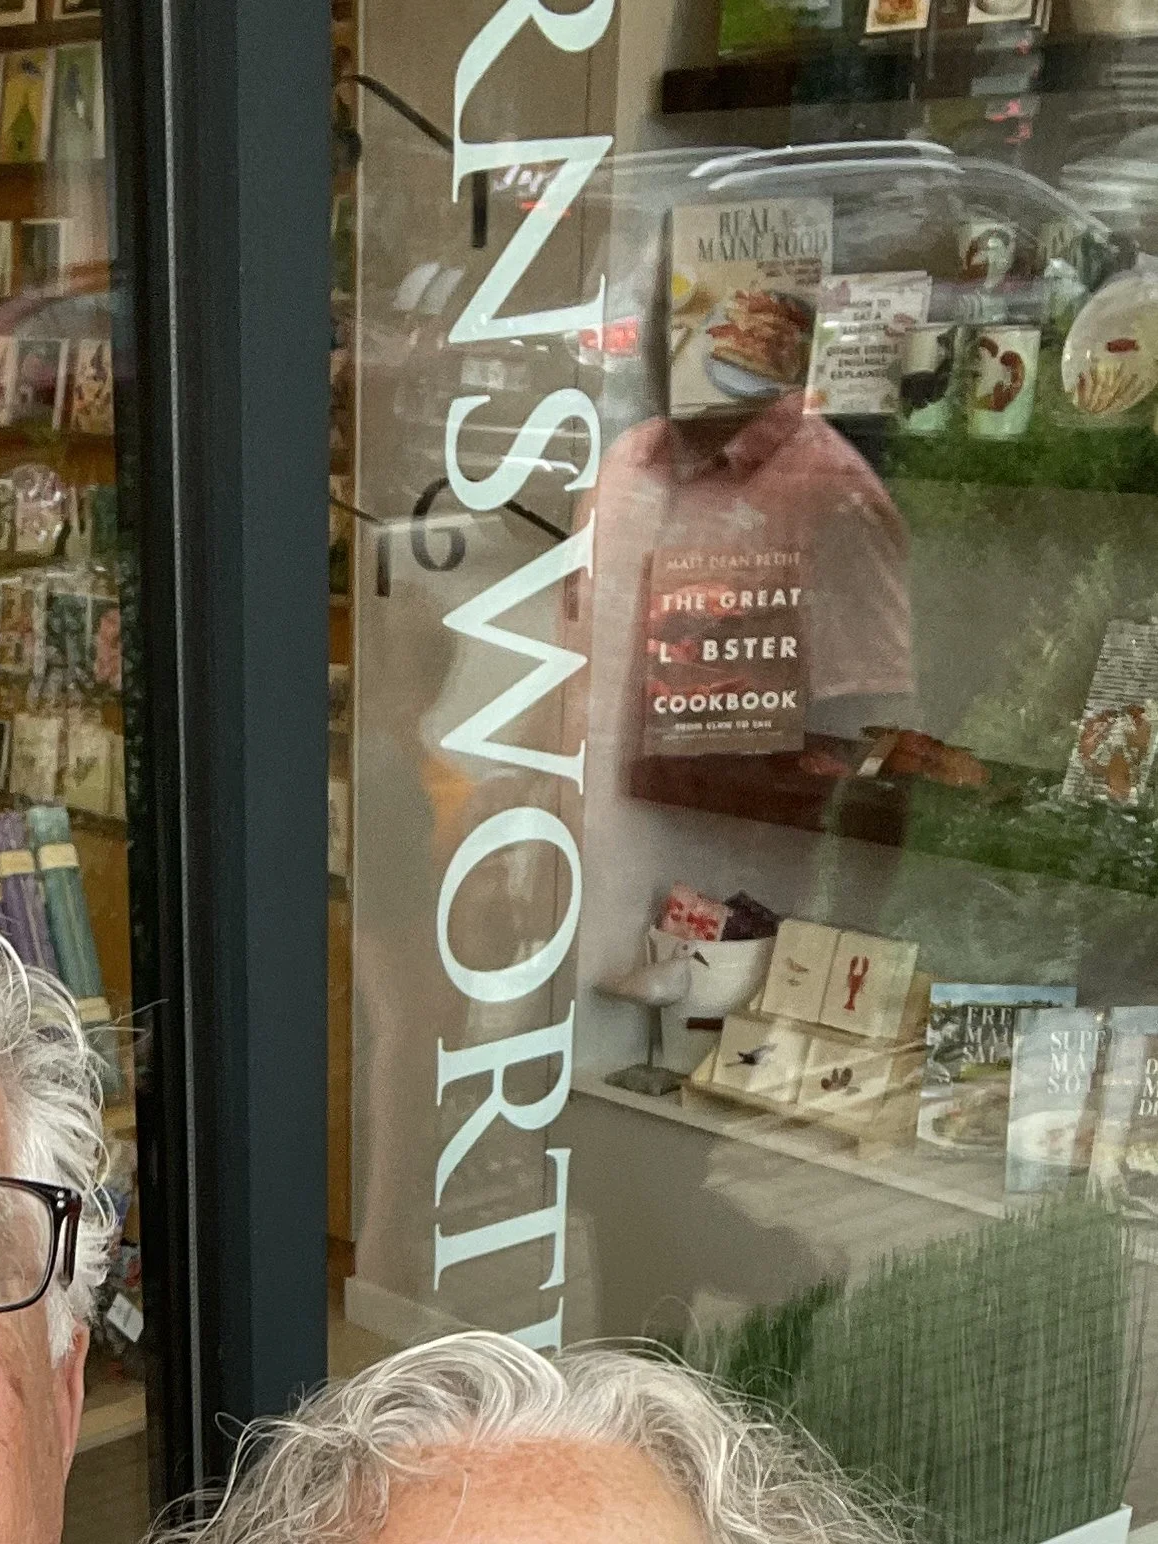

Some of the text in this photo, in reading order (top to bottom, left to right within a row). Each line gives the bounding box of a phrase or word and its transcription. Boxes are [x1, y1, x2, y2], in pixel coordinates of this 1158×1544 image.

[772, 230, 829, 258] FOOD
[662, 587, 801, 612] THE GREAT
[653, 690, 797, 714] COOKBOOK
